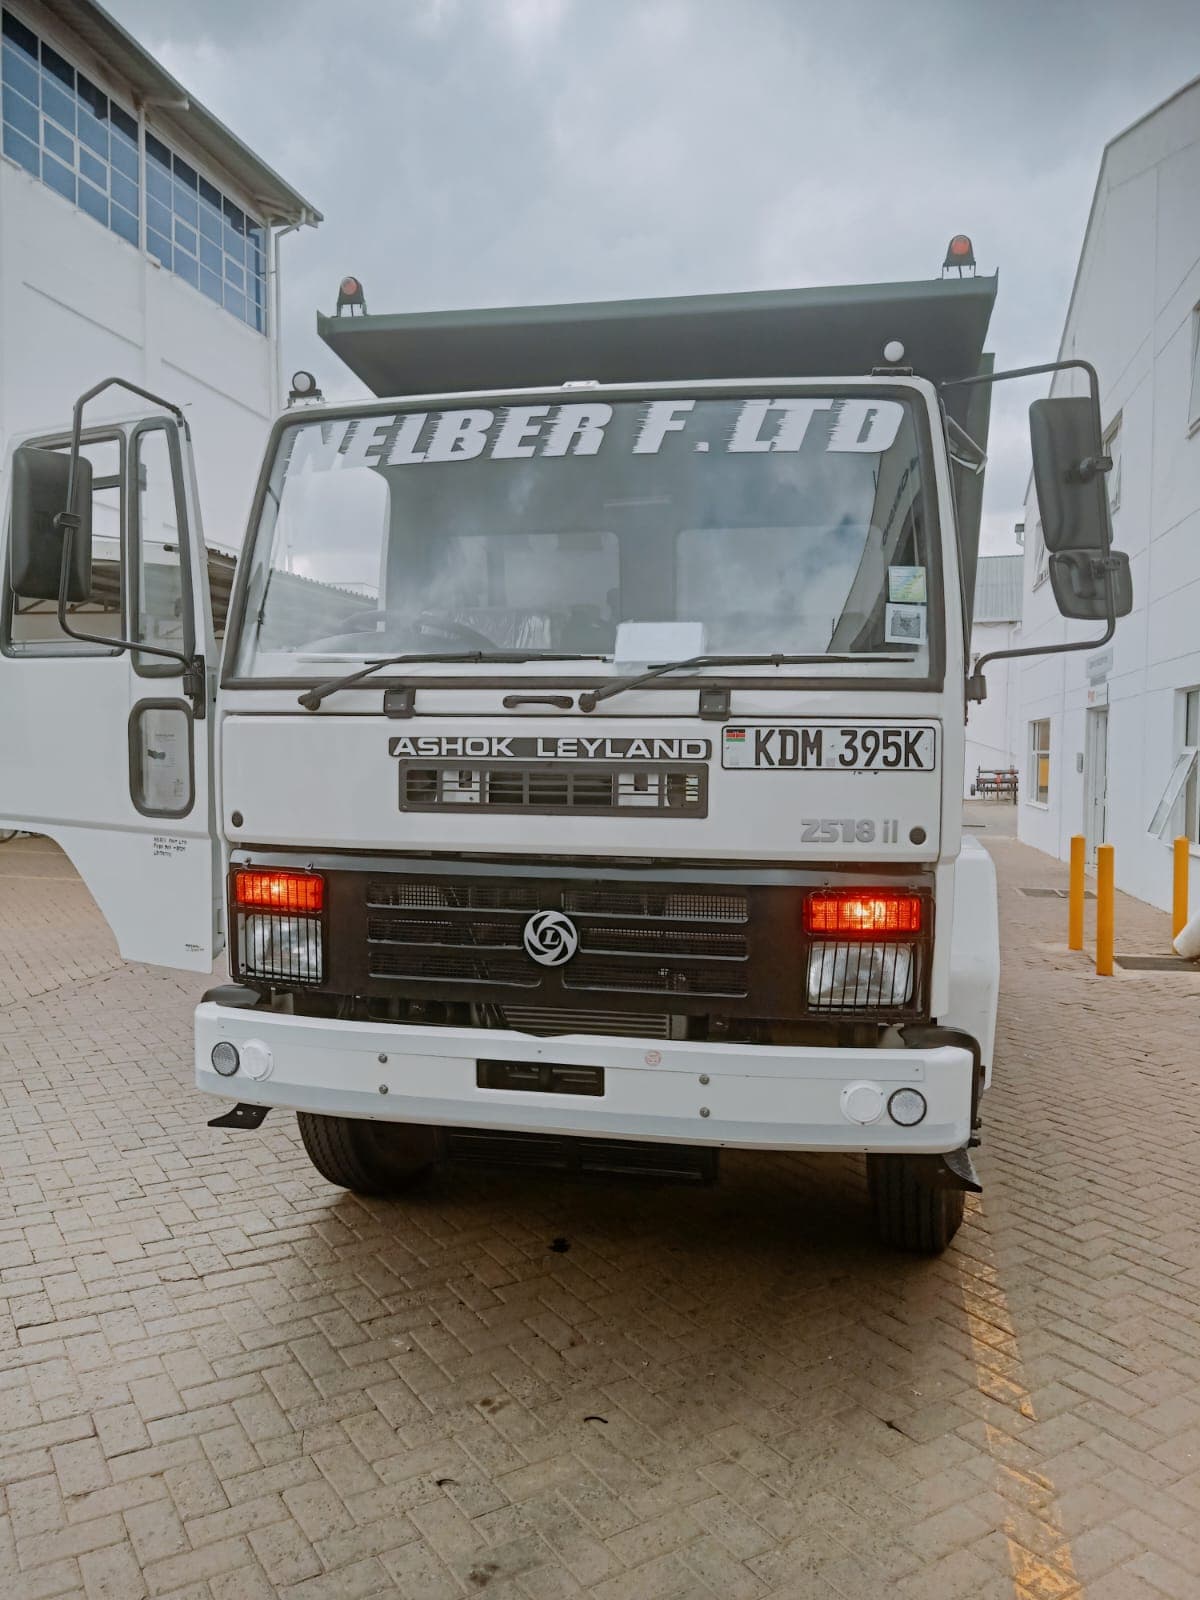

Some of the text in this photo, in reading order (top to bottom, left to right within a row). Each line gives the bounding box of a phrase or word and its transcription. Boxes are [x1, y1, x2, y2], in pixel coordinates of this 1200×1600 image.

[283, 402, 613, 474] NELBER
[726, 398, 904, 453] LTD
[393, 737, 708, 758] ASHOK LEYLAND
[754, 729, 925, 768] KDM 395K
[800, 818, 876, 844] 2518
[542, 929, 560, 946] L
